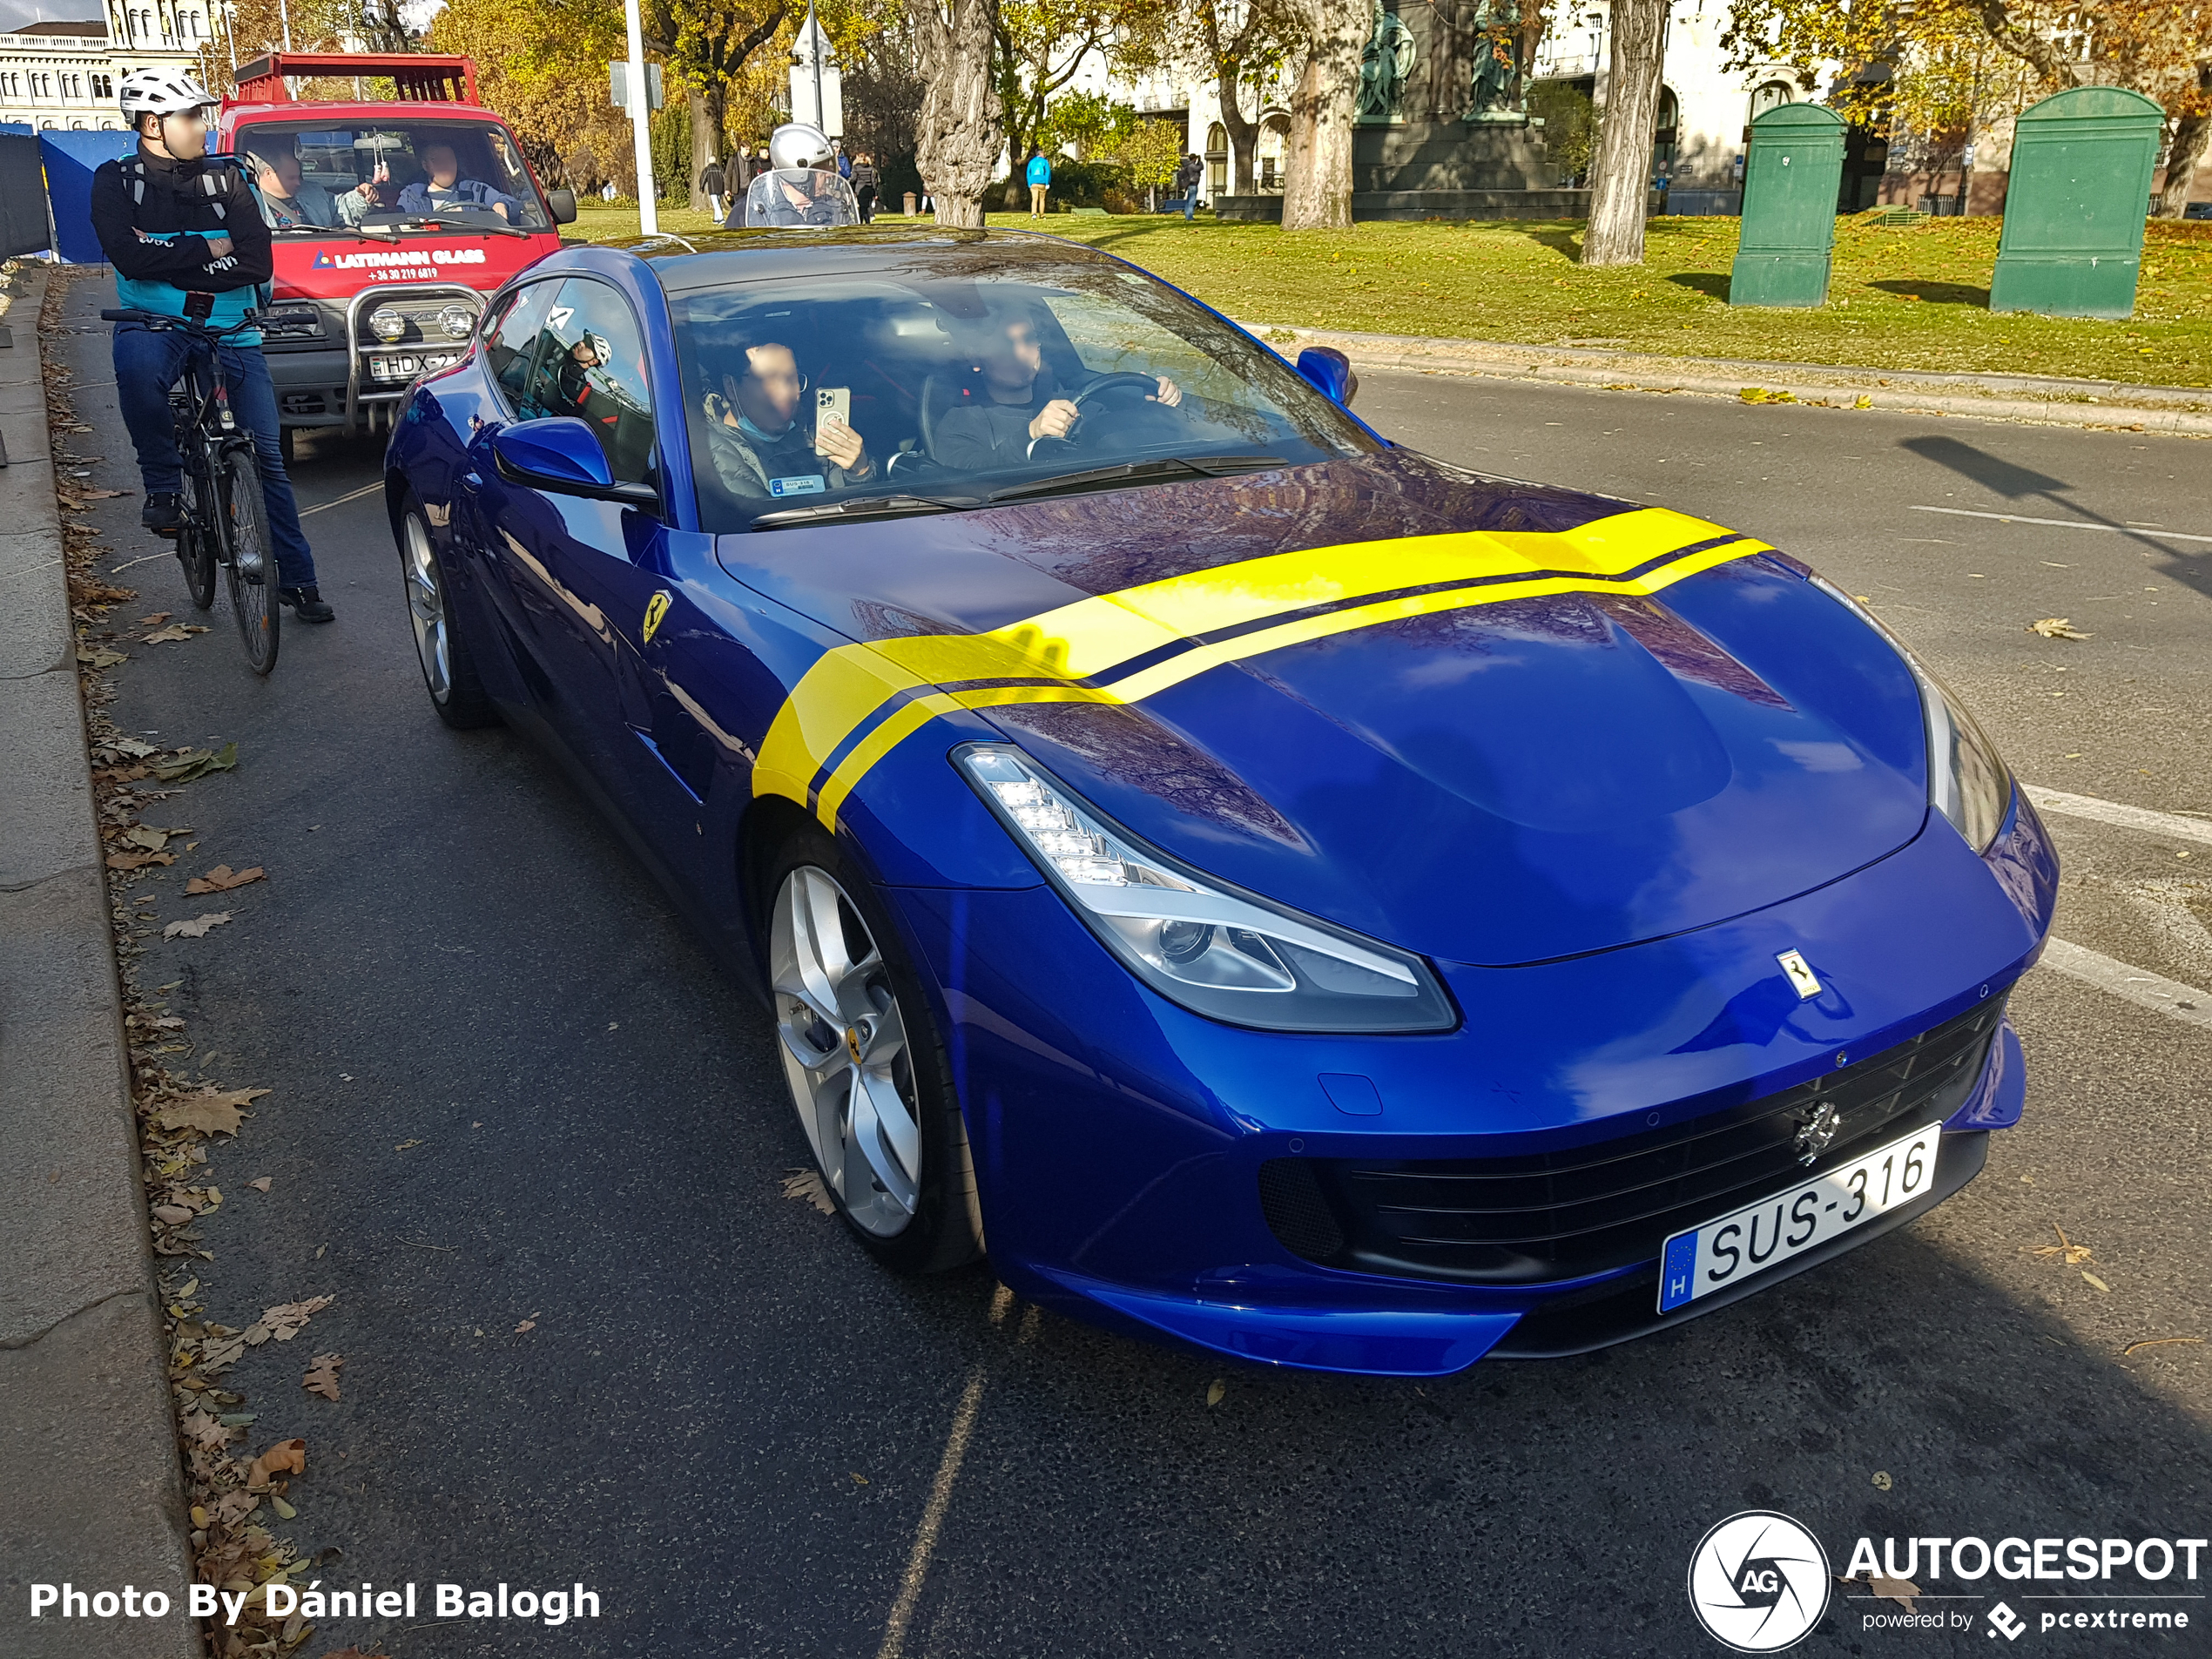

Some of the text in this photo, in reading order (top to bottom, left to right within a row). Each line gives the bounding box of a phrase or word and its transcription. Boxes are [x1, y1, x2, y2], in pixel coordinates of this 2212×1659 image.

[334, 249, 486, 269] LATTMANN GLASS
[368, 267, 438, 280] +36 30 219 6819
[1708, 1141, 1926, 1282] SUS-316
[1670, 1275, 1687, 1298] H
